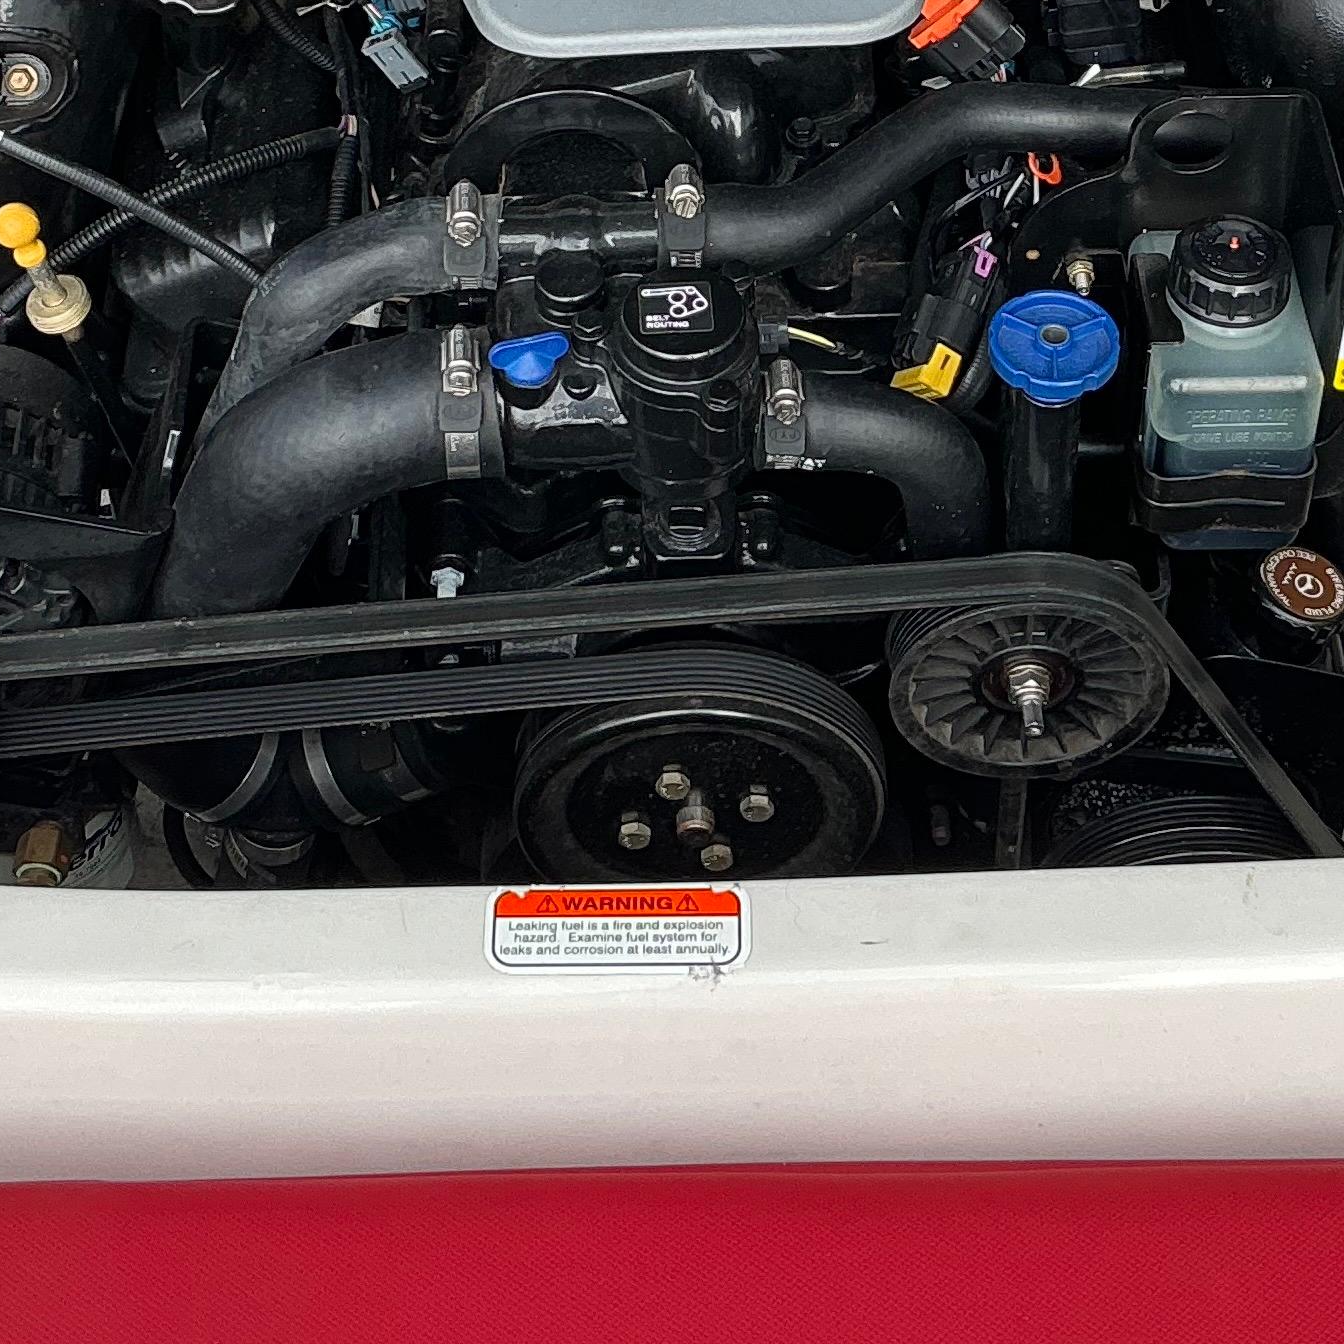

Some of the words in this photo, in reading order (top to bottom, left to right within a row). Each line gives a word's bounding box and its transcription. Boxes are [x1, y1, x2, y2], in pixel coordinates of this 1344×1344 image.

[645, 321, 690, 329] ROUTING
[1303, 605, 1335, 617] FLUID
[562, 895, 673, 911] WARNING
[508, 920, 558, 934] Leaking
[561, 920, 584, 931] fuel
[587, 921, 597, 931] is
[601, 923, 609, 931] a
[613, 920, 632, 931] fire
[636, 920, 659, 931] and
[663, 920, 724, 933] explosion
[568, 932, 622, 943] Examine
[626, 932, 649, 943] fuel
[652, 932, 697, 944] system
[700, 932, 717, 943] for
[499, 944, 532, 955] leaks
[536, 944, 560, 955] and
[564, 943, 624, 955] corrosion
[627, 944, 639, 954] at
[643, 943, 672, 955] least
[676, 943, 731, 957] annually.
